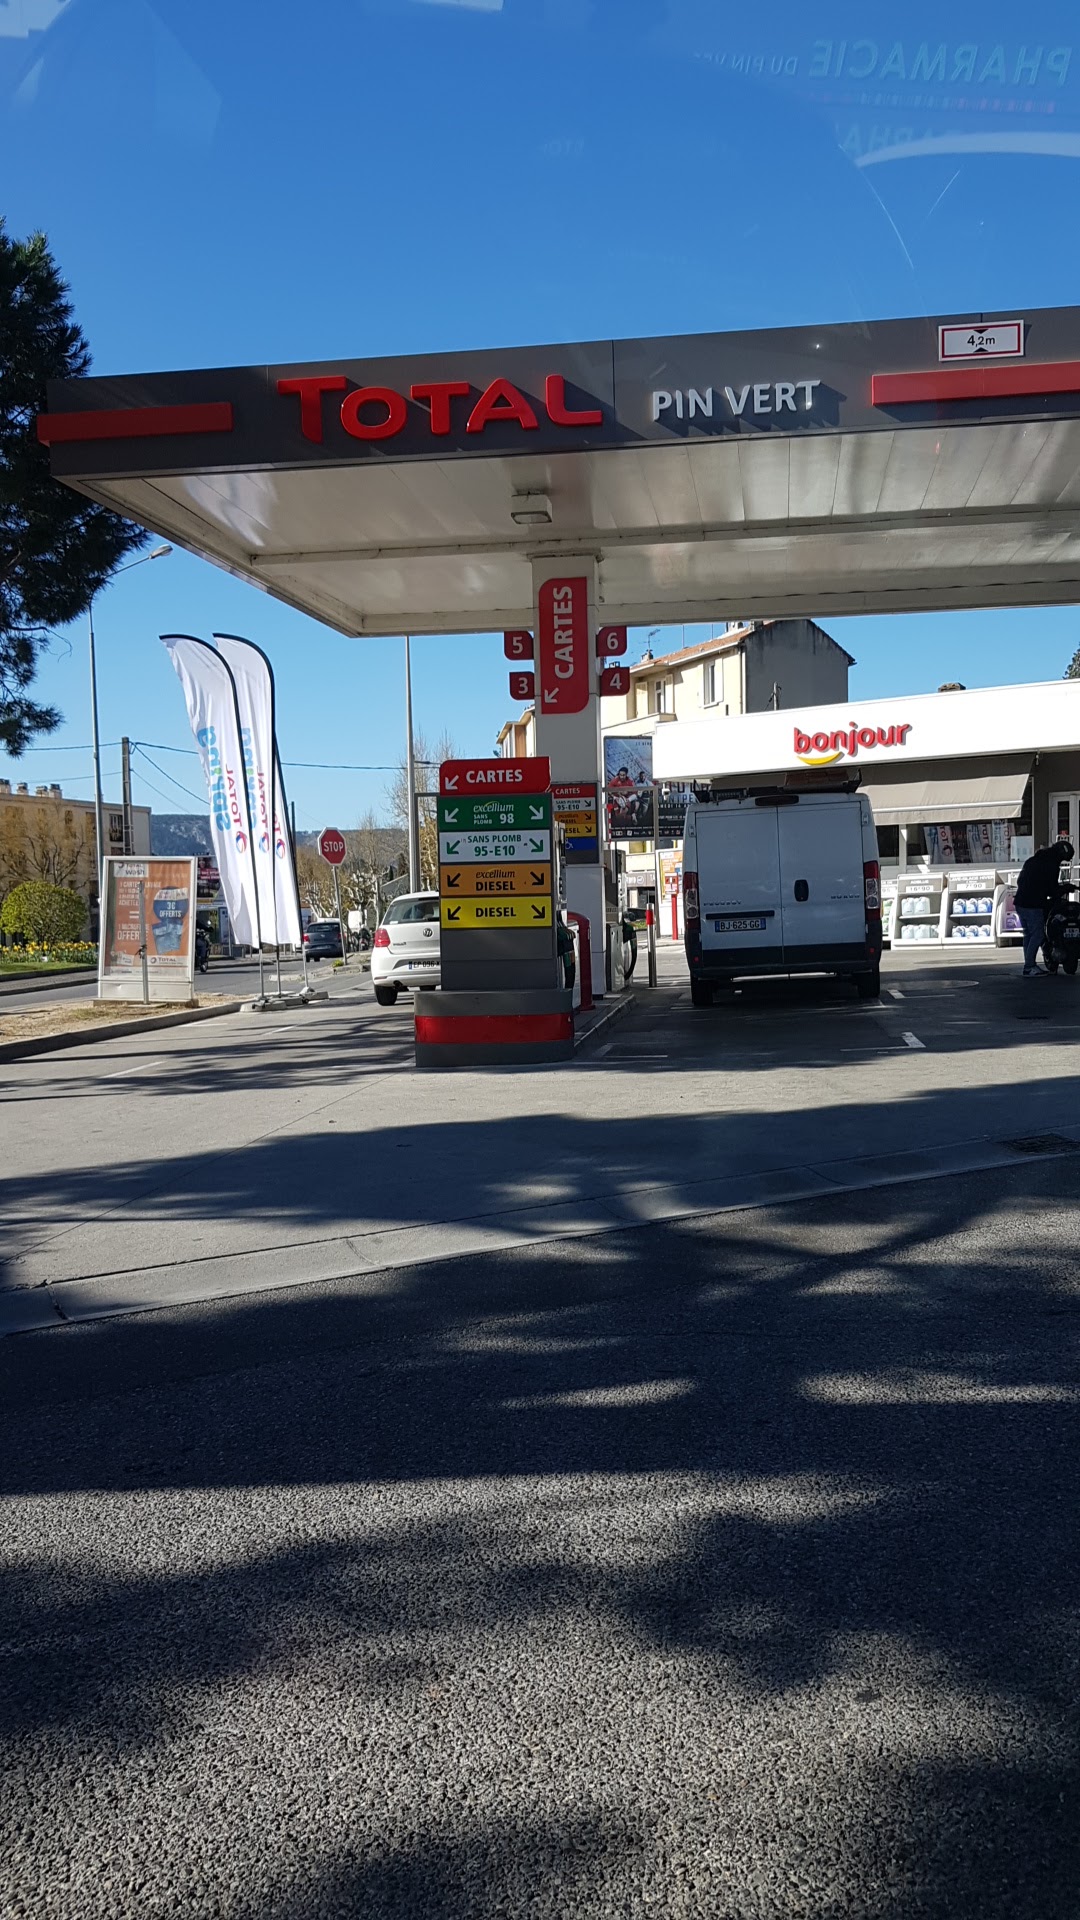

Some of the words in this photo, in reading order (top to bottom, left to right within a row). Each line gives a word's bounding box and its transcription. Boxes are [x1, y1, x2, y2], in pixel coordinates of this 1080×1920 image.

[967, 335, 996, 347] 4,2m
[652, 387, 713, 421] PIN
[724, 379, 821, 415] VERT
[276, 374, 603, 444] TOTAL
[553, 586, 574, 679] CARTES
[512, 636, 524, 654] 5
[606, 632, 619, 650] 6
[518, 677, 529, 694] 3
[609, 673, 622, 690] 4
[793, 721, 913, 757] bonjour
[465, 769, 523, 783] CARTES
[473, 801, 514, 813] excellium
[500, 813, 515, 824] 98
[467, 836, 490, 844] SANS
[492, 834, 522, 843] PLOMB
[323, 841, 343, 852] STOP
[474, 845, 516, 857] 95-E10
[475, 869, 516, 879] excellium
[475, 881, 516, 892] DIESEL
[160, 910, 182, 918] OFFERTS
[475, 907, 517, 918] DIESEL
